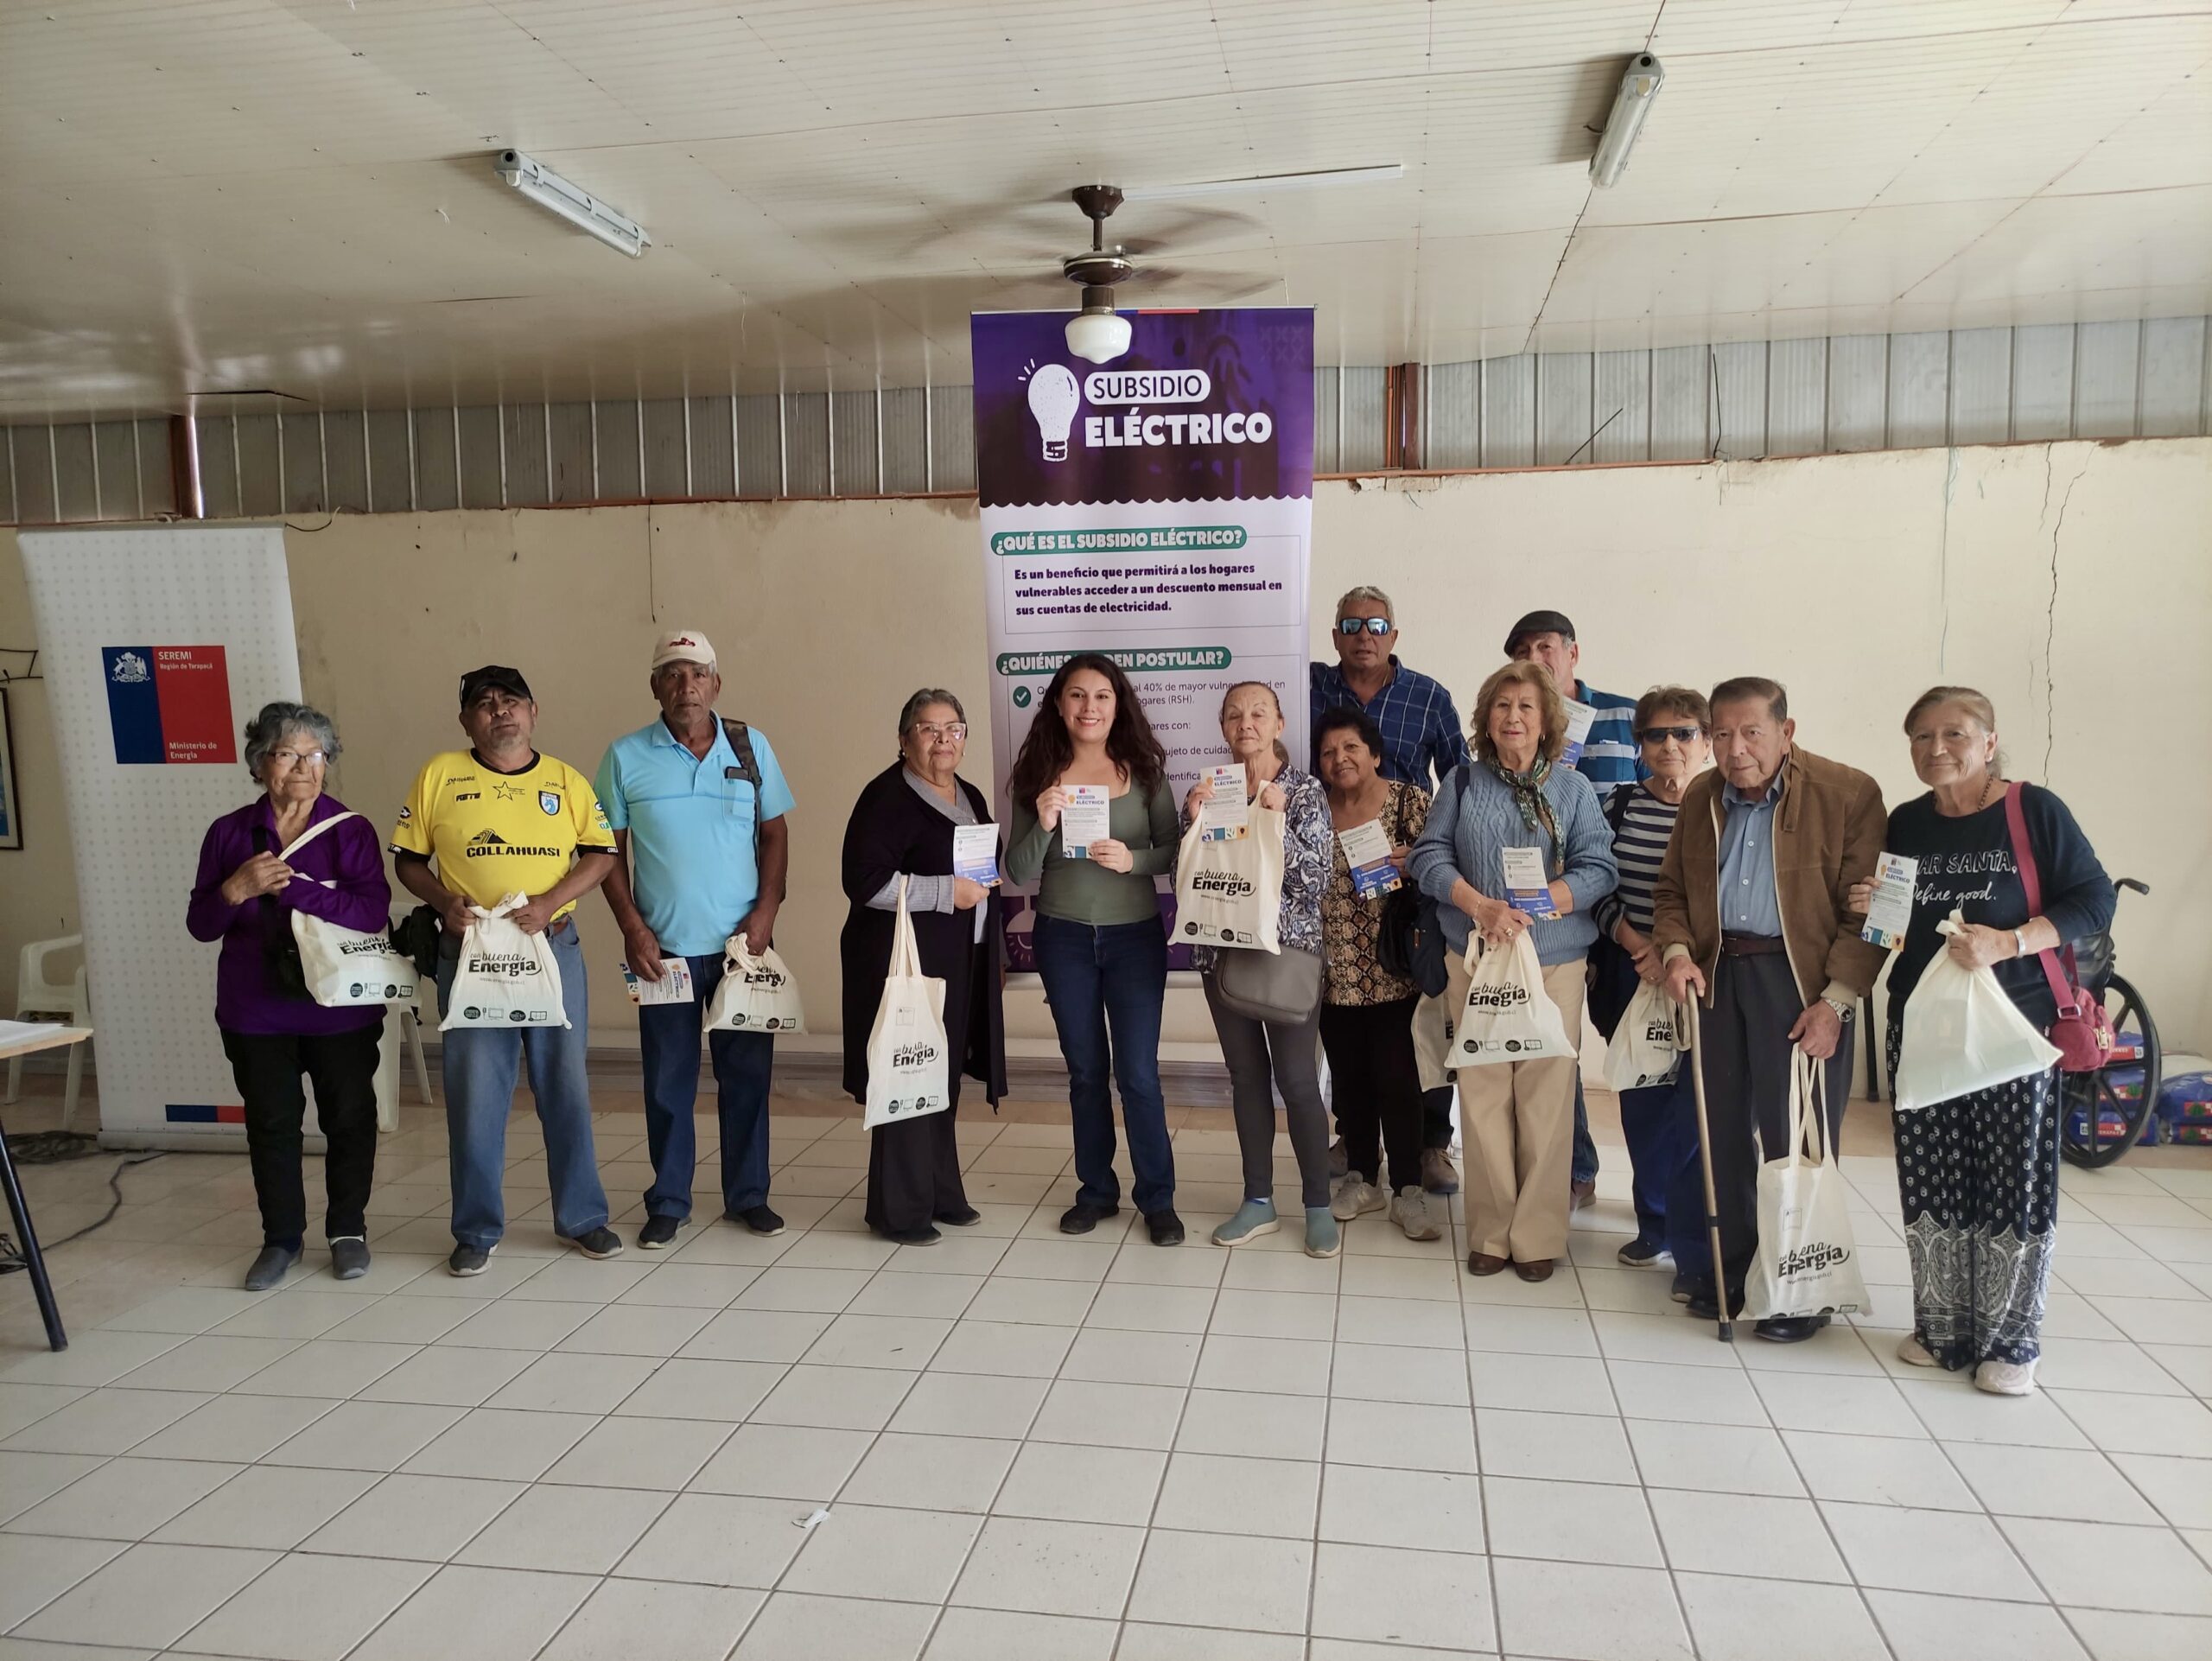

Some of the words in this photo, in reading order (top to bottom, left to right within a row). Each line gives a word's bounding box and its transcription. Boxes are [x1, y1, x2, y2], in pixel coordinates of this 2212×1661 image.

[1092, 374, 1203, 399] SUBSIDIO
[1084, 406, 1273, 448] ELÉCTRICO
[996, 532, 1036, 554] ¿QUÉ
[1037, 535, 1056, 550] ES
[1057, 534, 1076, 549] EL
[1077, 531, 1148, 549] SUBSIDIO
[1150, 528, 1243, 547] ELÉCTRICO?
[1014, 570, 1027, 580] Es
[1029, 570, 1044, 579] un
[1046, 567, 1099, 579] beneficio
[1101, 569, 1122, 580] que
[1125, 563, 1179, 579] permitirá
[1180, 566, 1188, 576] a
[1190, 563, 1207, 575] los
[1209, 563, 1255, 576] hogares
[1015, 586, 1083, 598] vulnerables
[1084, 584, 1129, 595] acceder
[1131, 586, 1138, 595] a
[1140, 585, 1154, 594] un
[1156, 582, 1216, 594] descuento
[1217, 580, 1266, 591] mensual
[1268, 582, 1282, 590] en
[1015, 606, 1035, 615] sus
[1037, 604, 1082, 614] cuentas
[1084, 602, 1097, 614] de
[1099, 600, 1173, 613] electricidad.
[158, 651, 193, 660] SEREMI
[1135, 651, 1224, 667] POSTULAR?
[1143, 682, 1165, 692] 40%
[1165, 682, 1177, 691] de
[1179, 682, 1207, 693] mayor
[1138, 698, 1166, 707] ogares
[1167, 695, 1195, 706] (RSH).
[168, 741, 207, 750] Ministerio
[1165, 747, 1188, 758] ujeto
[1190, 746, 1202, 755] de
[466, 846, 561, 858] COLLAHUASI
[1946, 850, 2018, 875] SANTA,
[1205, 867, 1241, 881] buena
[1192, 877, 1251, 896] Energía
[1955, 881, 1997, 909] good.
[481, 951, 524, 962] buena
[468, 956, 537, 977] Energía
